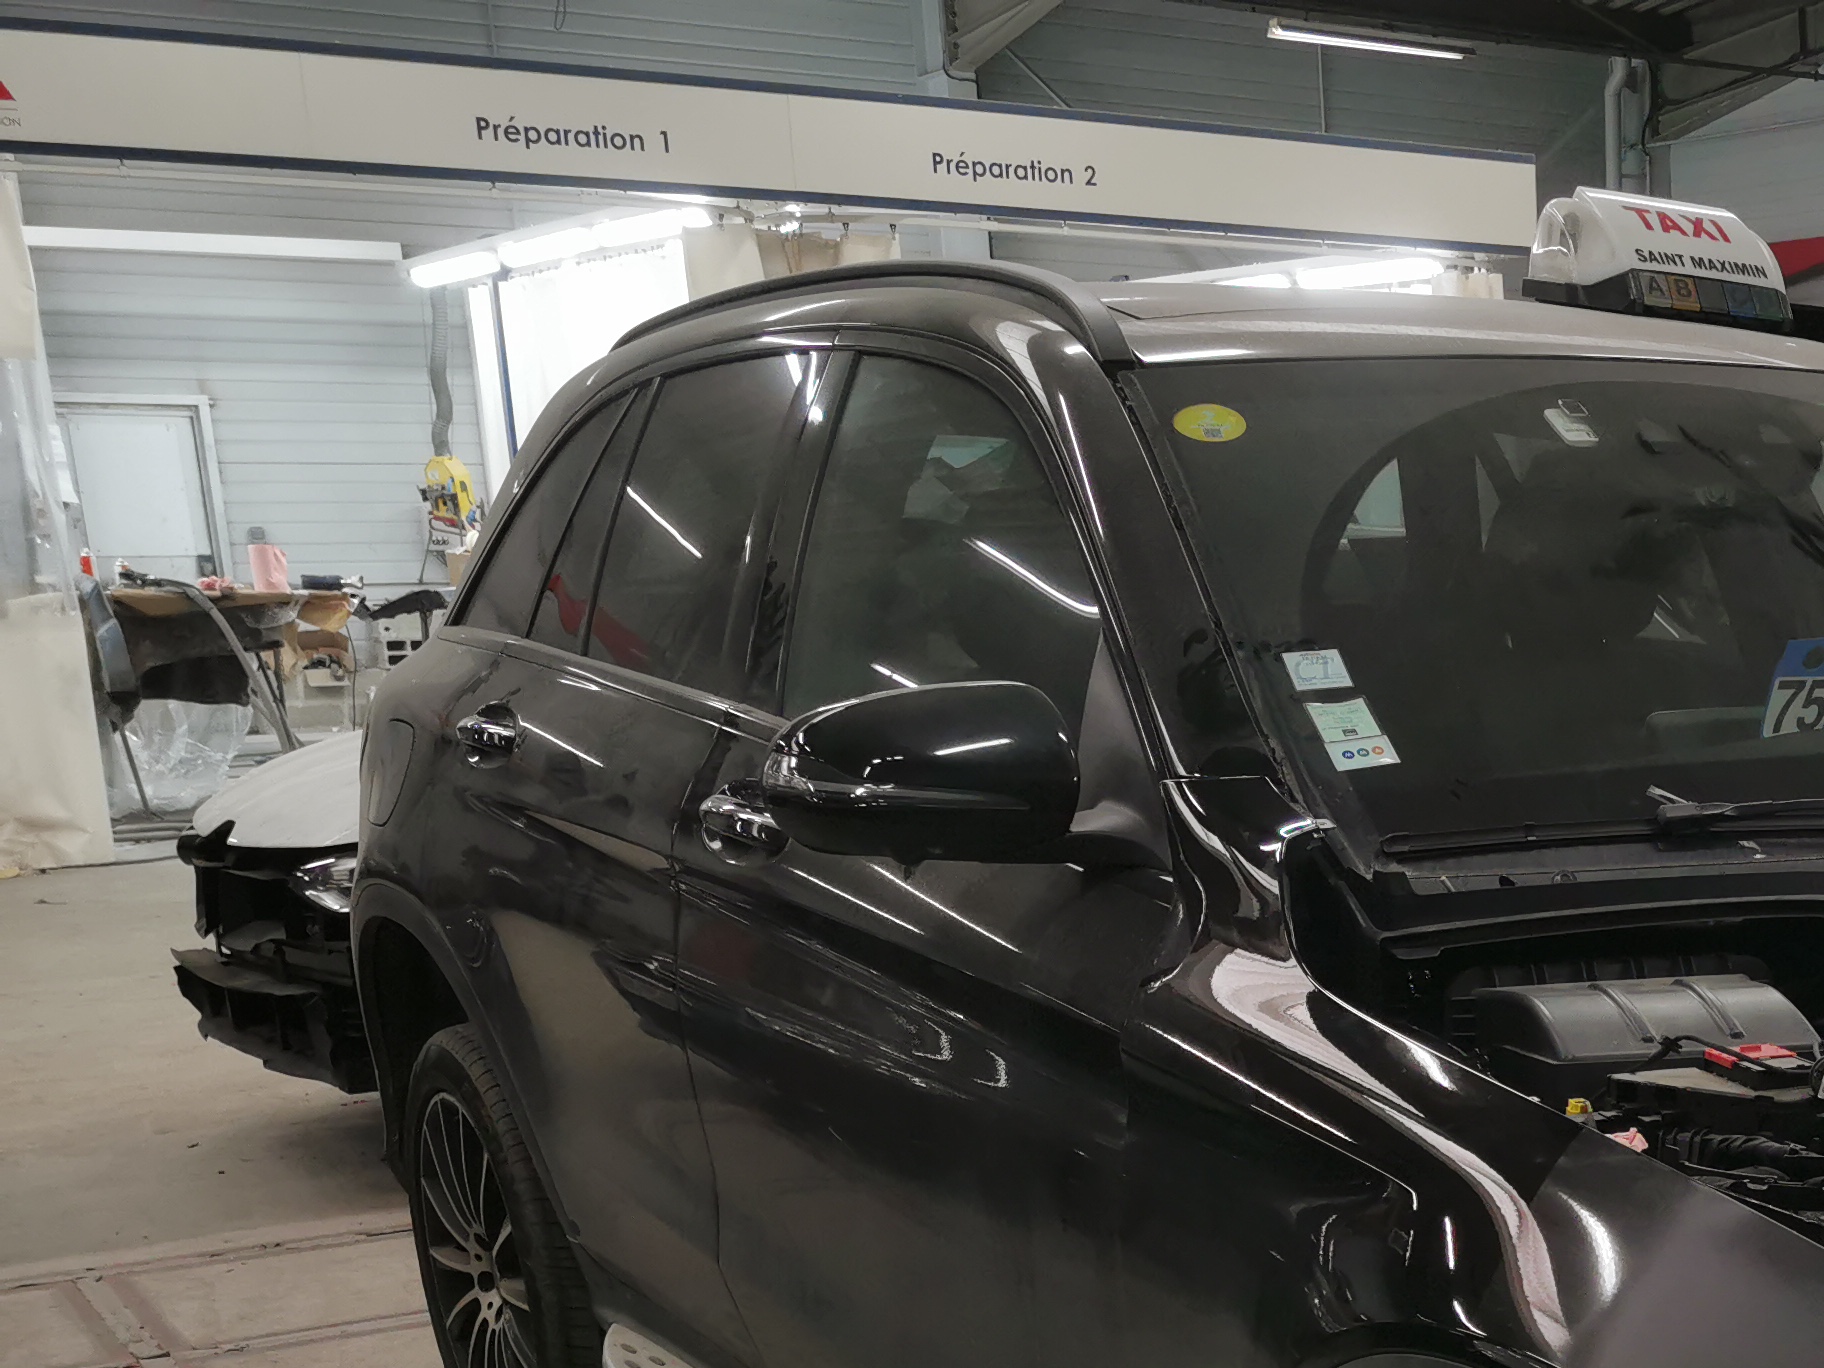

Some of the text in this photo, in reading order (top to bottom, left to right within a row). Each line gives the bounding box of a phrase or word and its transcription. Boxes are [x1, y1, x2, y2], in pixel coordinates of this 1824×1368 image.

[475, 115, 670, 153] Préparation 1
[932, 151, 1098, 186] Préparation 2
[1621, 205, 1732, 243] TAXI
[1634, 248, 1769, 280] SAINT MAXIMIN
[1648, 275, 1692, 298] A B
